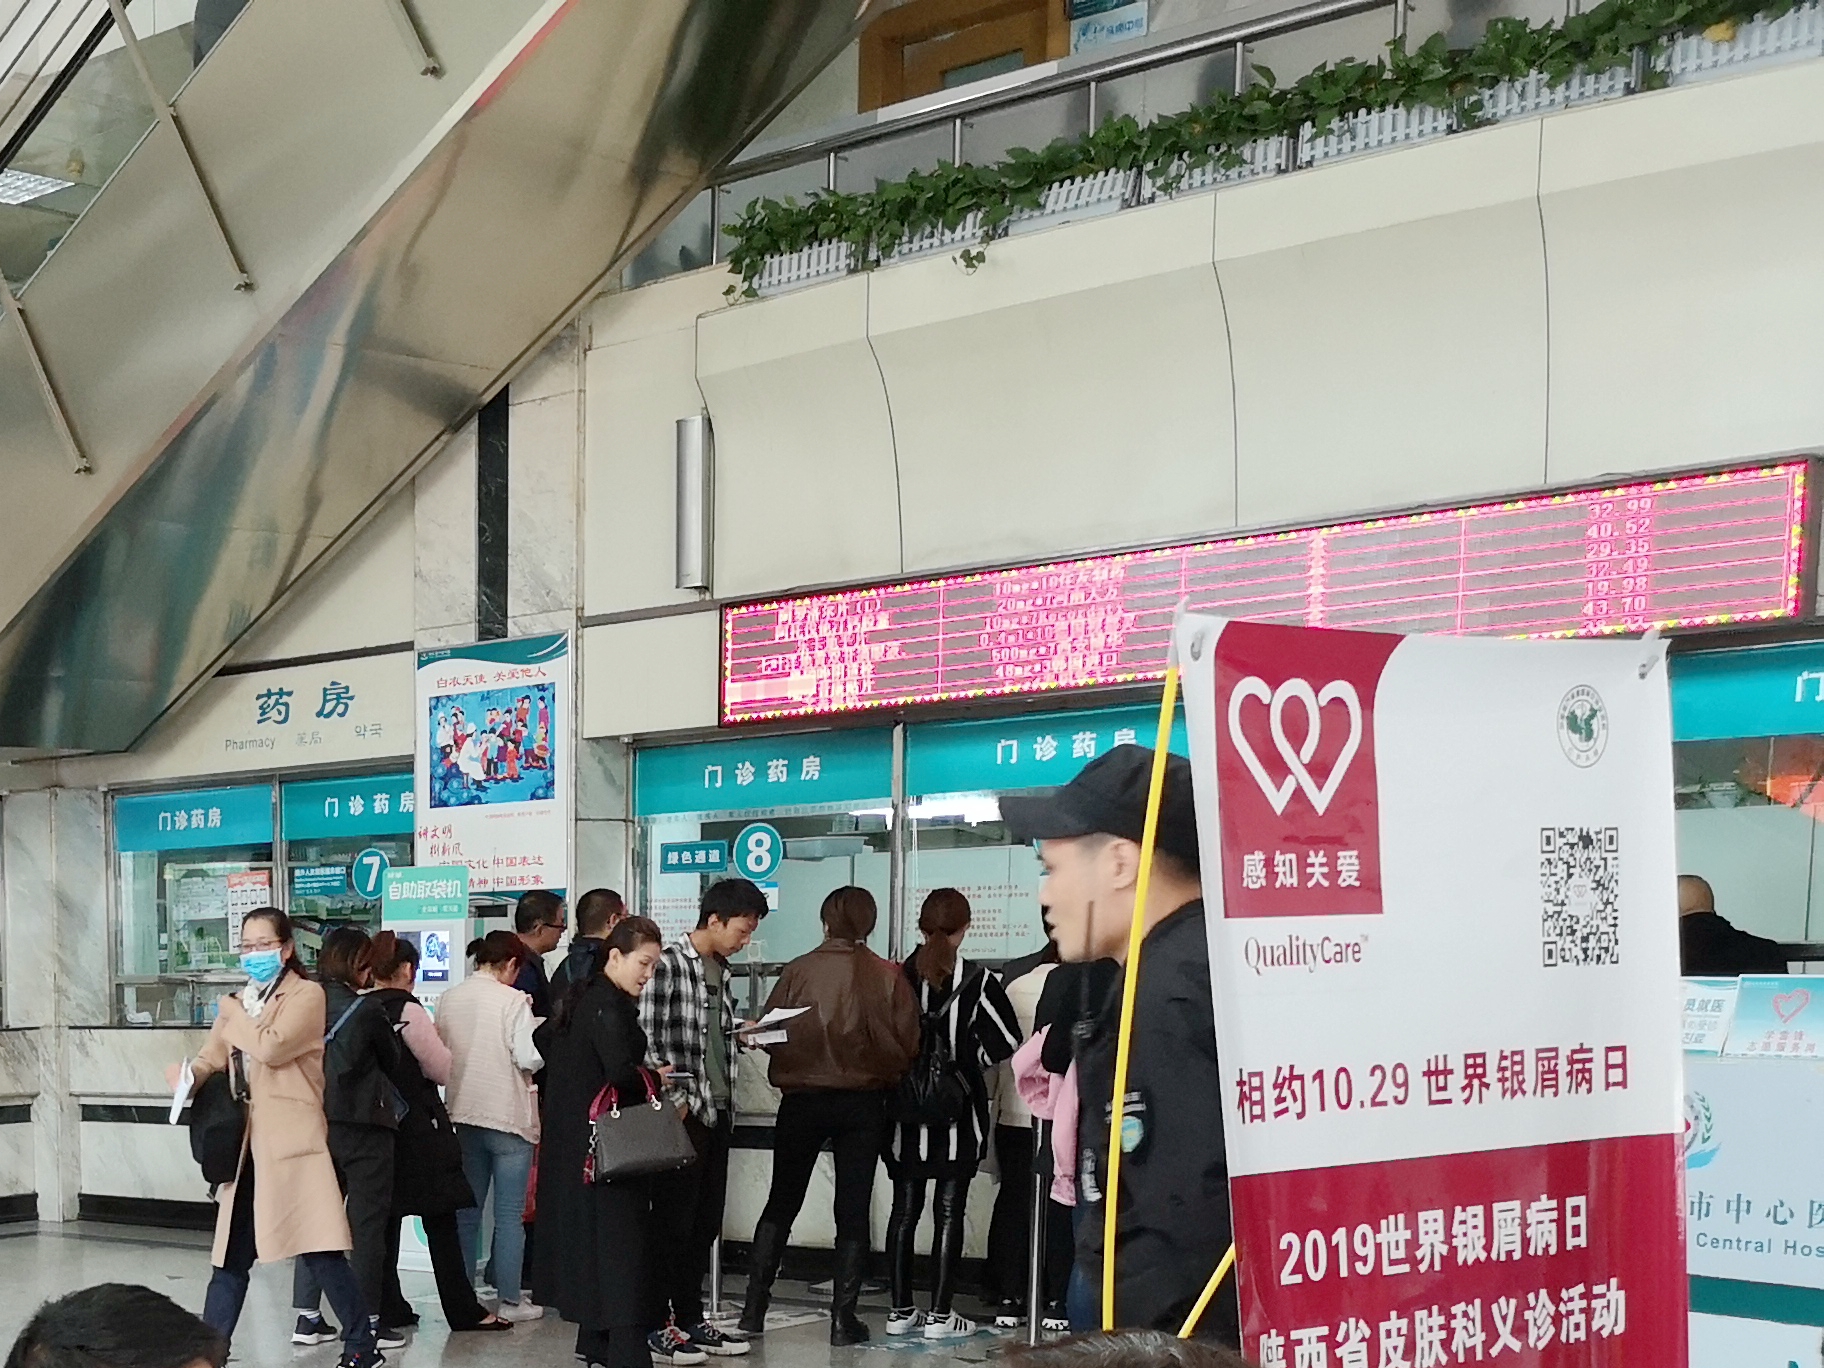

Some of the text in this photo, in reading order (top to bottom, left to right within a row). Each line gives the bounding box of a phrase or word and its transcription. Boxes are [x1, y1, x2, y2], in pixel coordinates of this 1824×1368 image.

[436, 666, 547, 689] 白衣天使 关爱他人
[256, 681, 356, 725] 药房
[225, 737, 275, 752] Pharmacy
[354, 722, 383, 740] 약국
[996, 728, 1138, 765] 门诊药房
[703, 755, 822, 789] 门诊药房
[324, 790, 414, 818] 门诊药房
[158, 808, 222, 831] 门诊药房
[418, 824, 453, 841] 讲文明
[667, 849, 721, 865] 绿色通道
[746, 831, 772, 872] 8
[362, 856, 380, 892] 7
[1241, 848, 1363, 889] 感知关爱
[388, 879, 462, 900] 自助取袋机
[1235, 1044, 1629, 1127] 相约10.29 世界银屑病日
[1279, 1194, 1589, 1287] 2019世界银屑病日
[1696, 1231, 1773, 1254] Central
